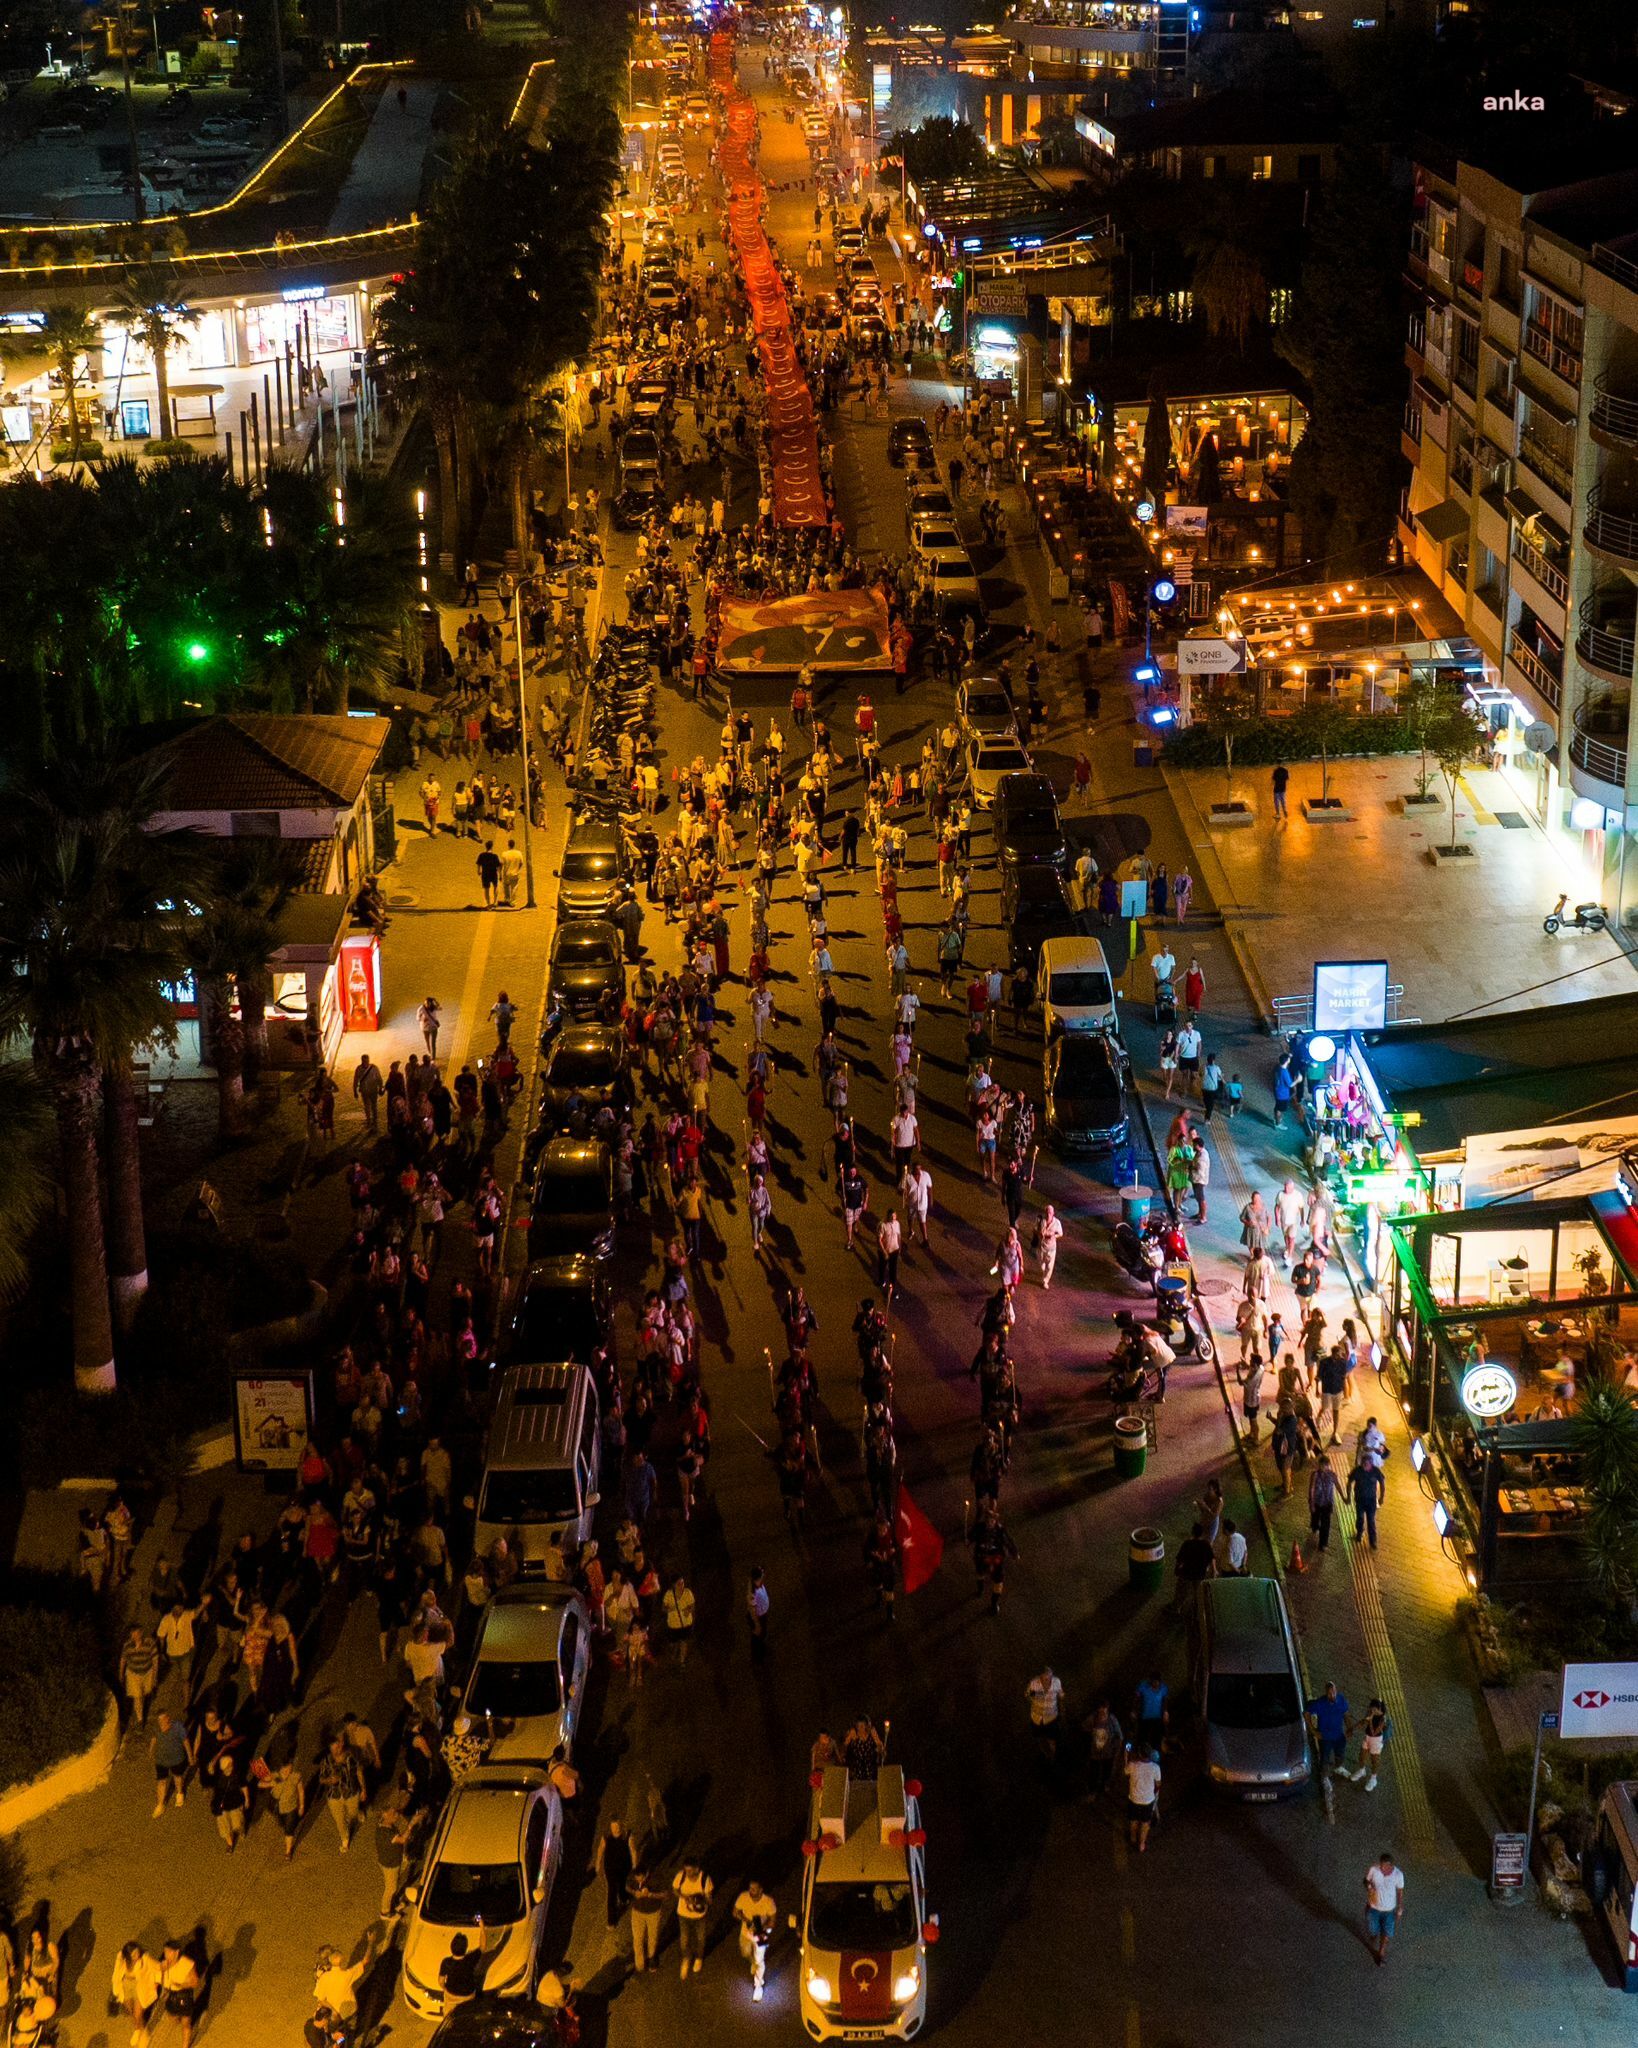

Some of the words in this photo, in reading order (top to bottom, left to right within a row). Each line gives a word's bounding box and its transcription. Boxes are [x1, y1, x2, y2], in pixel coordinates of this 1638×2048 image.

[980, 294, 1025, 307] OTOPARK
[1200, 651, 1222, 659] QNB
[1328, 998, 1371, 1008] MARKET
[254, 1398, 266, 1408] 21
